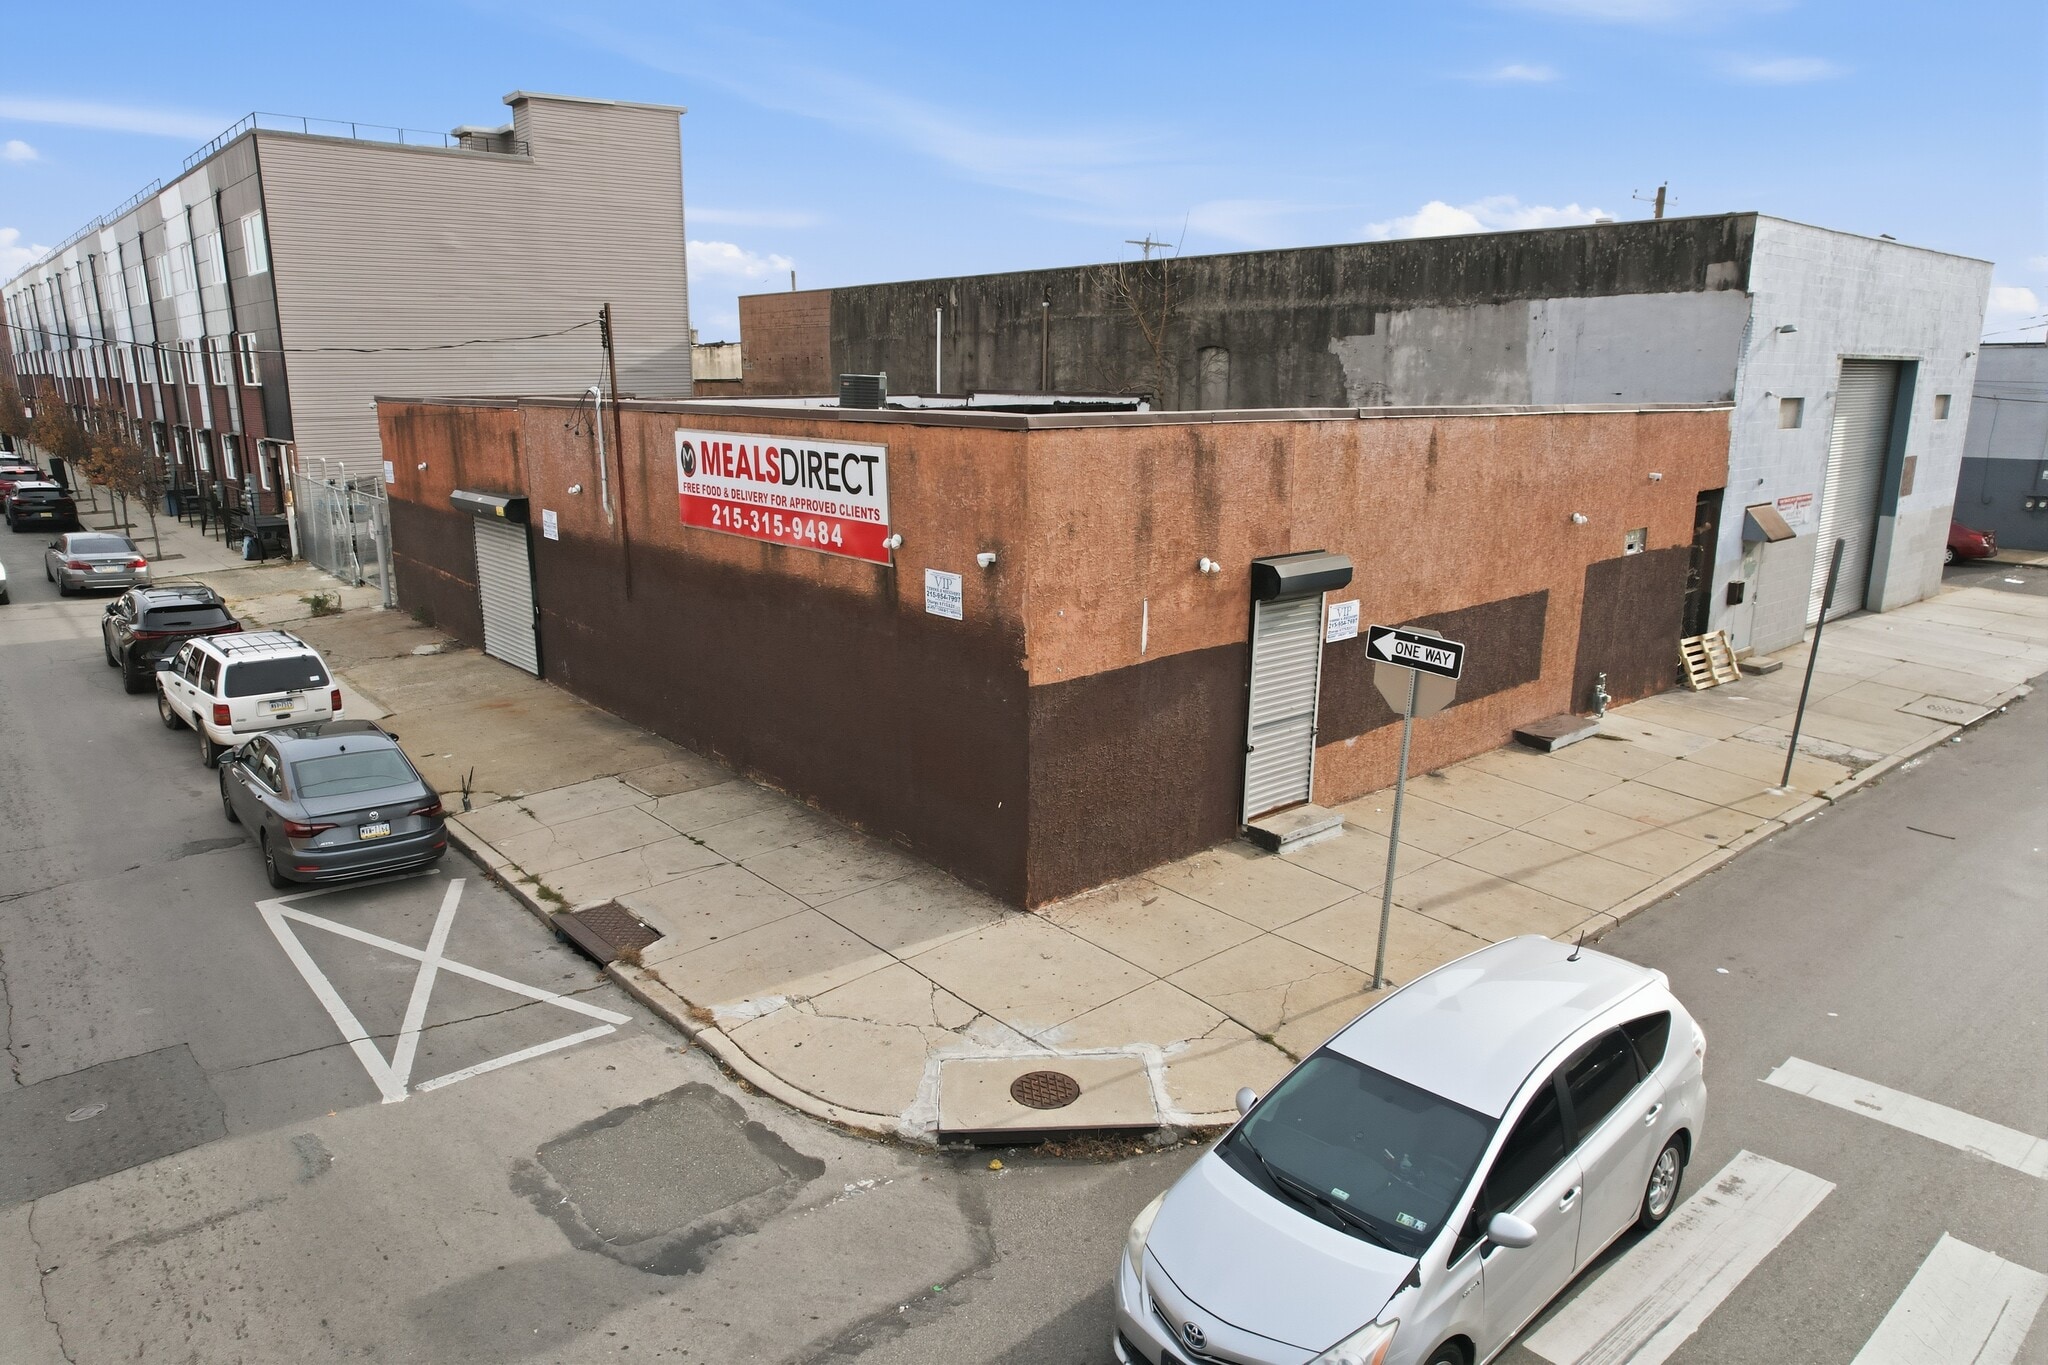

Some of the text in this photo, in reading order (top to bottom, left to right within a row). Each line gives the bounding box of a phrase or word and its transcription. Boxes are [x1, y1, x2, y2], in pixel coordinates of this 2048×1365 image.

[700, 441, 879, 496] MEALSDIRECT
[683, 482, 880, 521] FREE FOOD & DELIVERY FOR APPROVED CLIENTS
[712, 504, 843, 548] 215-315-9484
[934, 576, 953, 590] VIP
[1395, 641, 1451, 665] ONE WAY
